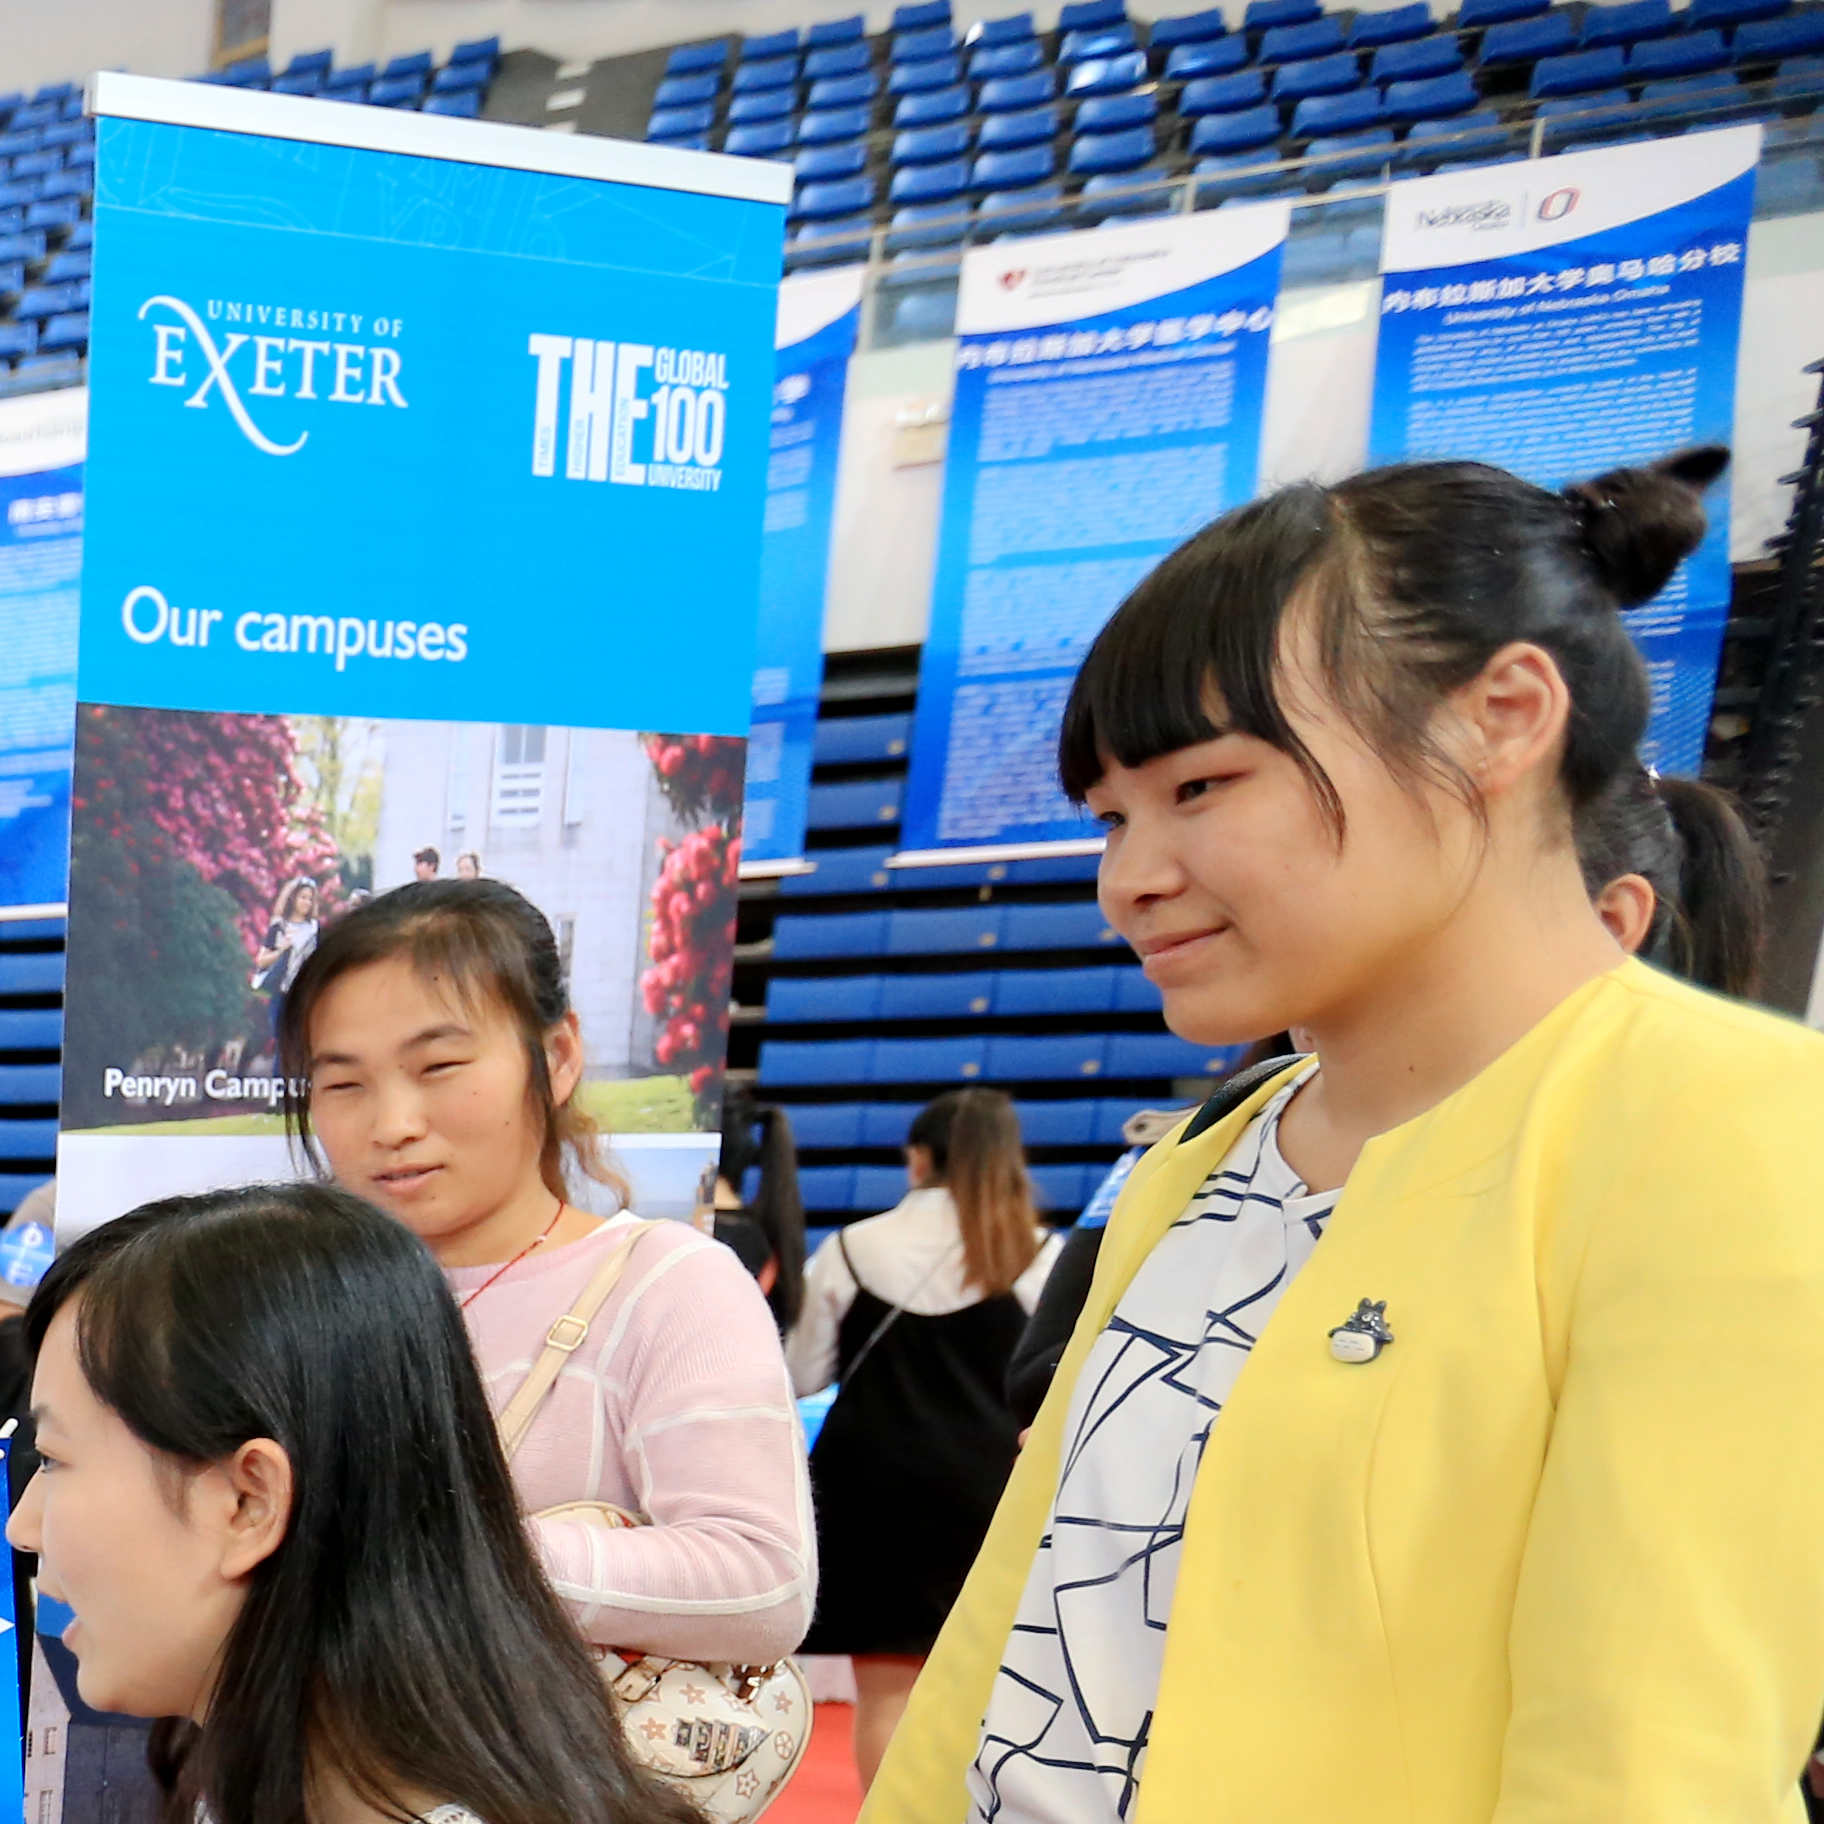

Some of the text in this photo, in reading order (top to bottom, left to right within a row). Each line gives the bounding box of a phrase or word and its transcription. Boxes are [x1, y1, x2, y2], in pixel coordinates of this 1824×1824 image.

[207, 299, 403, 338] UNIVERSITY OF
[138, 295, 408, 456] EXETER
[528, 333, 730, 486] THE GLOBAL
[651, 385, 726, 467] 100
[648, 463, 722, 492] UNIVERSITY
[122, 585, 469, 672] Our campuses
[104, 1067, 312, 1106] Penryn Campu
